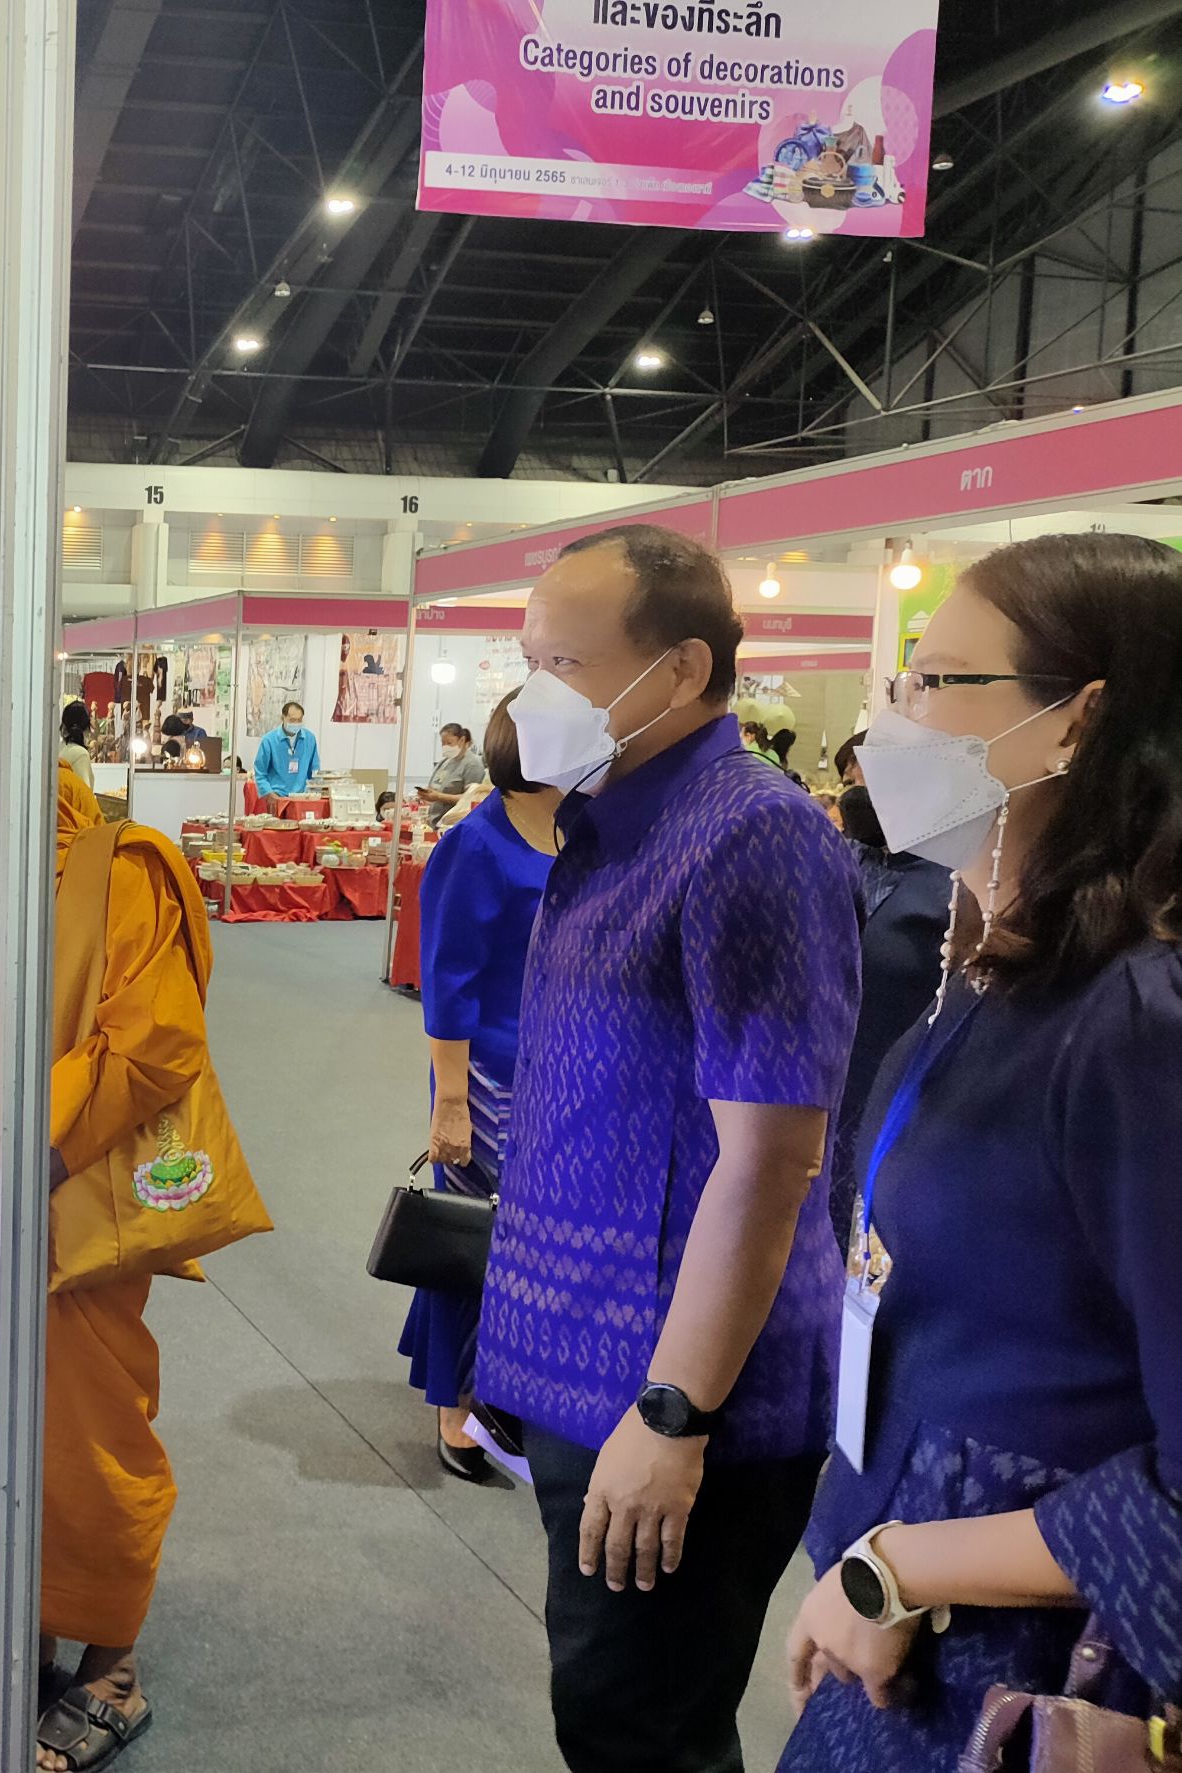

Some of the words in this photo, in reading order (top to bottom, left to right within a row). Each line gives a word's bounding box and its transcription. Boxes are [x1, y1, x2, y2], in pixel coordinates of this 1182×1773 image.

[523, 38, 657, 77] Categories
[667, 52, 692, 78] of
[699, 54, 844, 88] decorations
[594, 85, 641, 111] and
[650, 93, 770, 120] souvenirs
[445, 164, 475, 177] 4-12
[480, 164, 531, 184] มิถุนายน
[536, 169, 566, 184] 2565
[960, 466, 993, 491] ตาก
[144, 485, 164, 505] 15
[400, 495, 419, 514] 16
